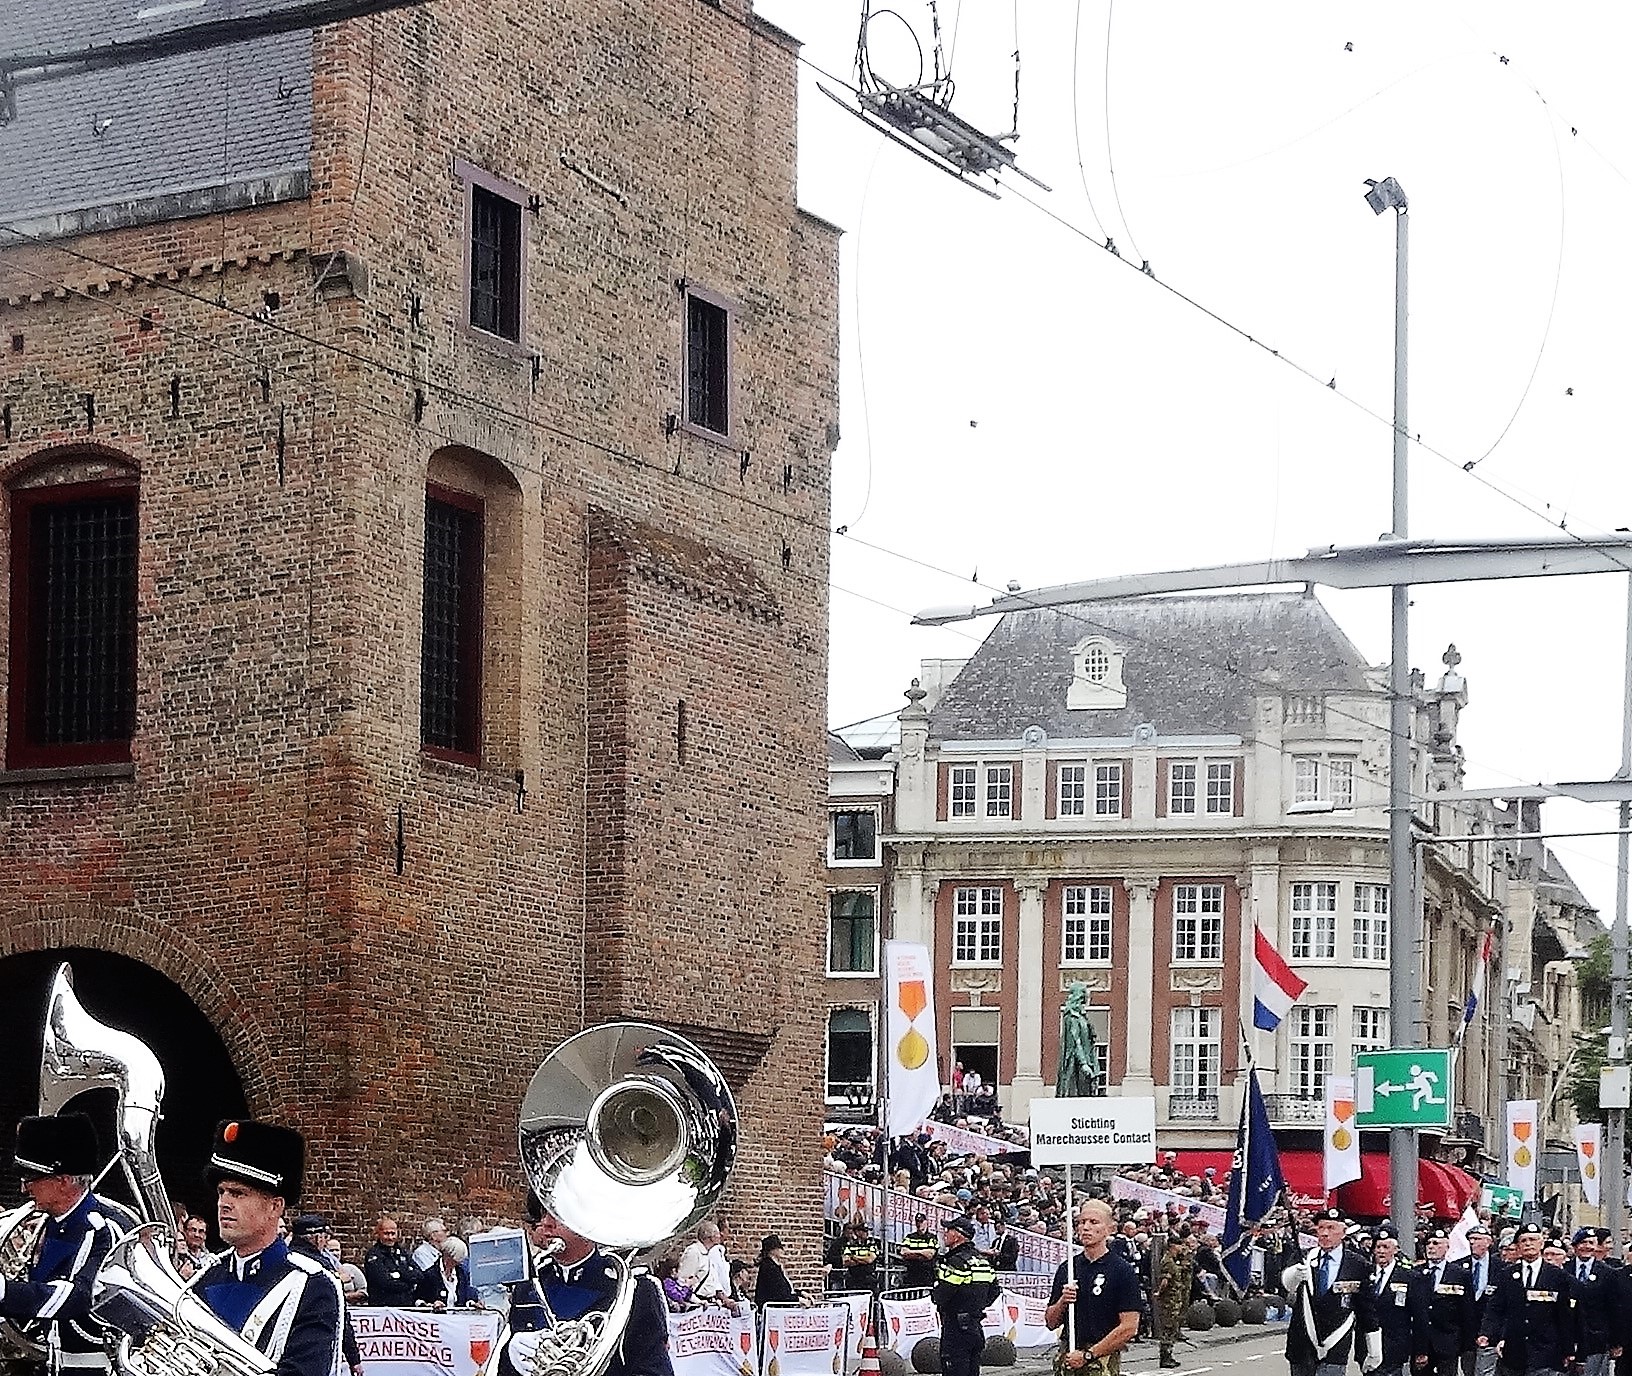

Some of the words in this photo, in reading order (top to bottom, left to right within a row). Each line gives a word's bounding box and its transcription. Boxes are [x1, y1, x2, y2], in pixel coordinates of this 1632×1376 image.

[1071, 1118, 1115, 1129] Stichting
[1036, 1133, 1109, 1145] Marechaussee
[1113, 1132, 1151, 1143] Contact
